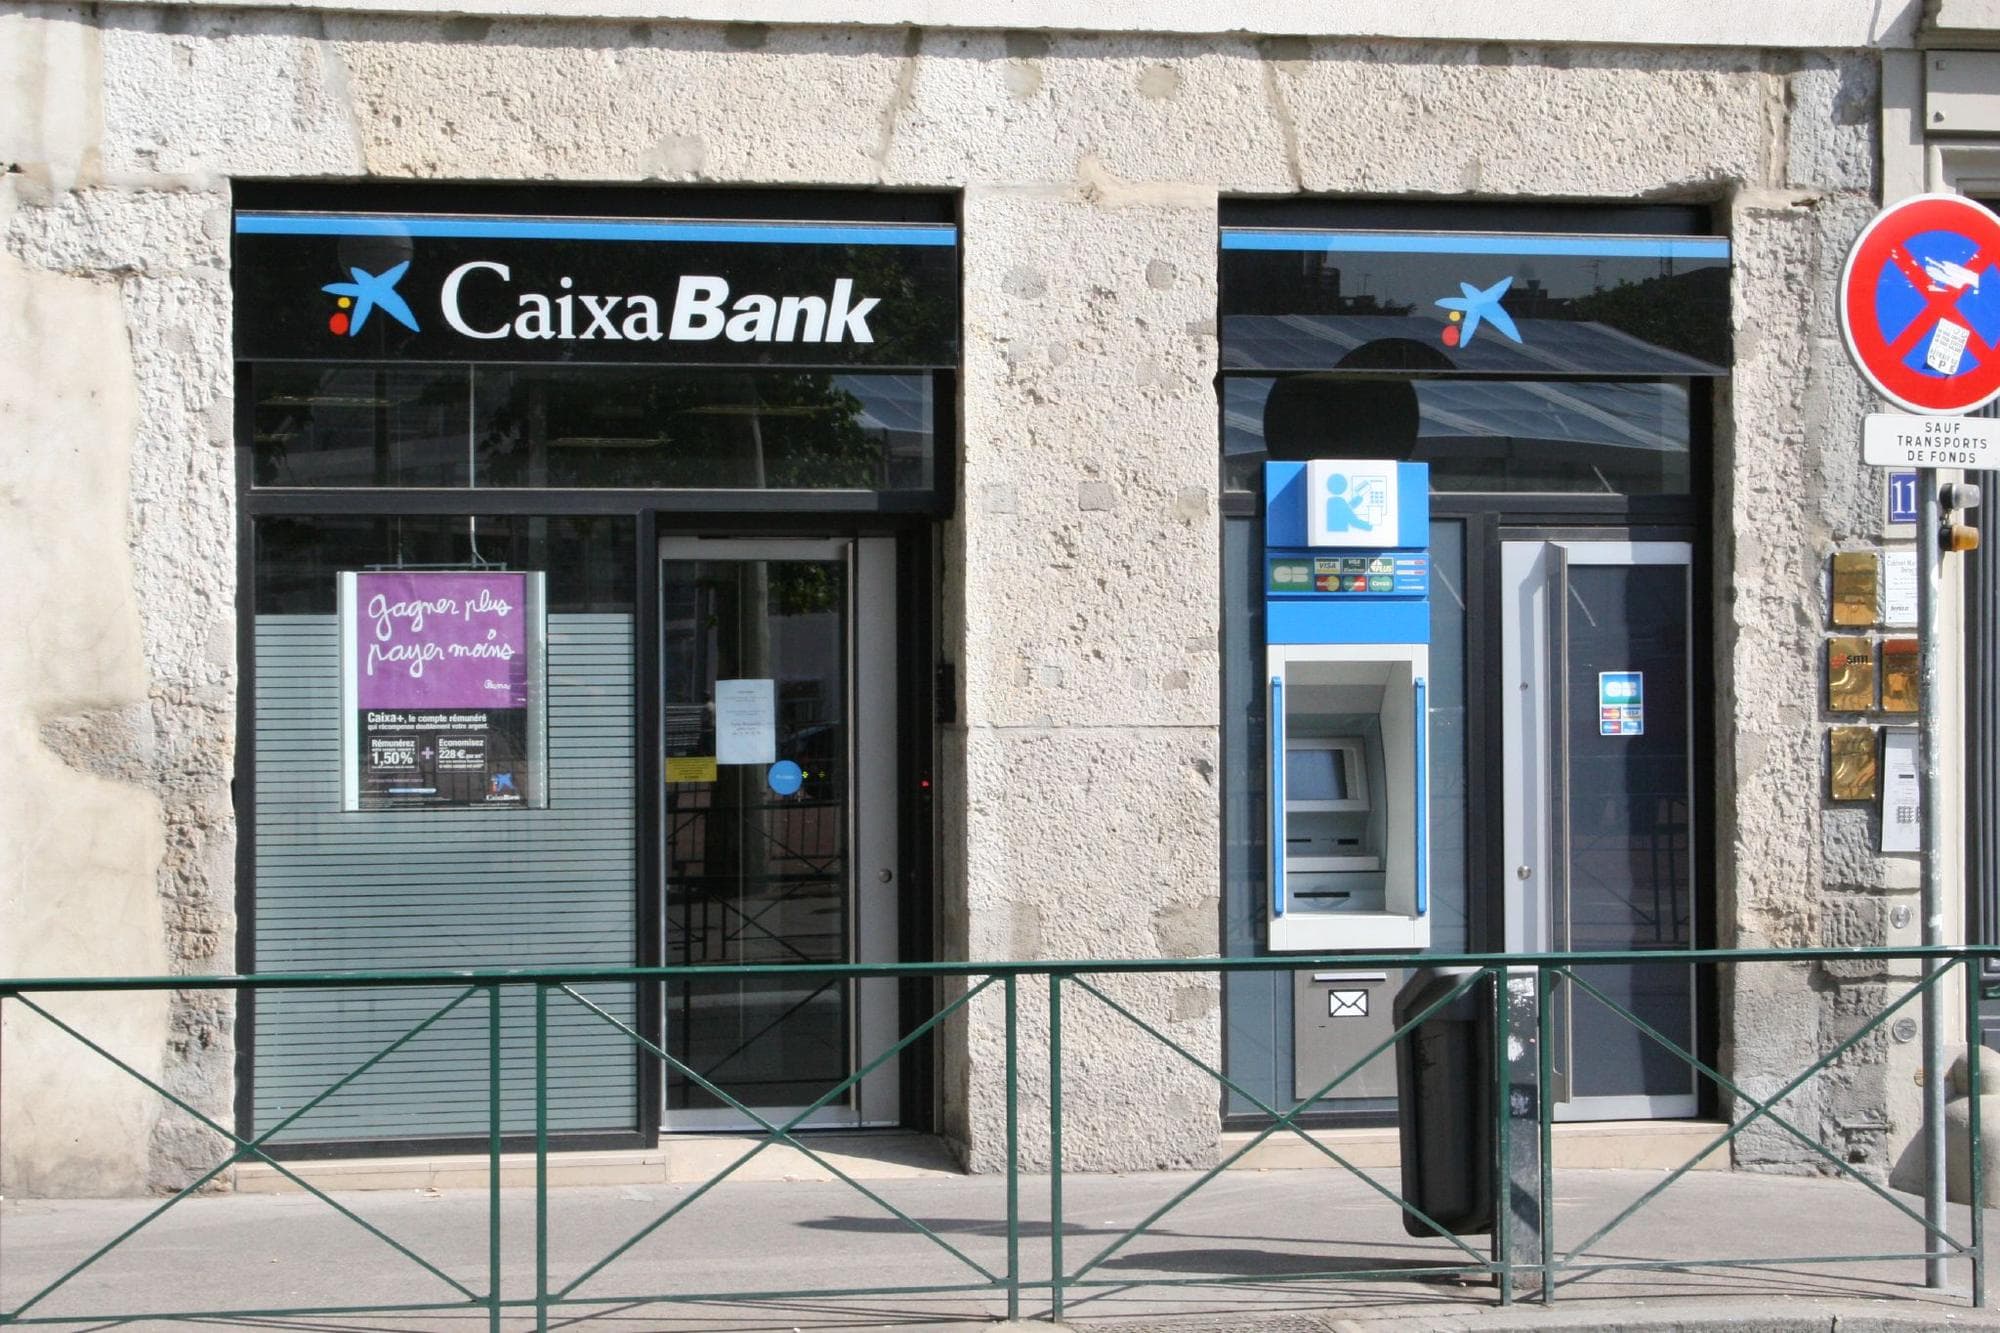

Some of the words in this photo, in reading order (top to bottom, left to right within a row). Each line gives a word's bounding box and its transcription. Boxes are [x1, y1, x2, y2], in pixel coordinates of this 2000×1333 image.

[441, 260, 881, 344] CaixaBank
[1925, 422, 1961, 434] SAUF
[1897, 435, 1988, 450] TRANSPORTS
[1907, 450, 1924, 462] DE
[1929, 451, 1977, 464] FONDS
[465, 589, 513, 621] plus
[367, 642, 446, 678] payer
[448, 628, 515, 660] moins
[408, 714, 416, 722] le
[418, 714, 447, 724] compte
[449, 713, 487, 722] rémunéré
[371, 739, 415, 747] Rémunérez
[439, 749, 456, 759] 228
